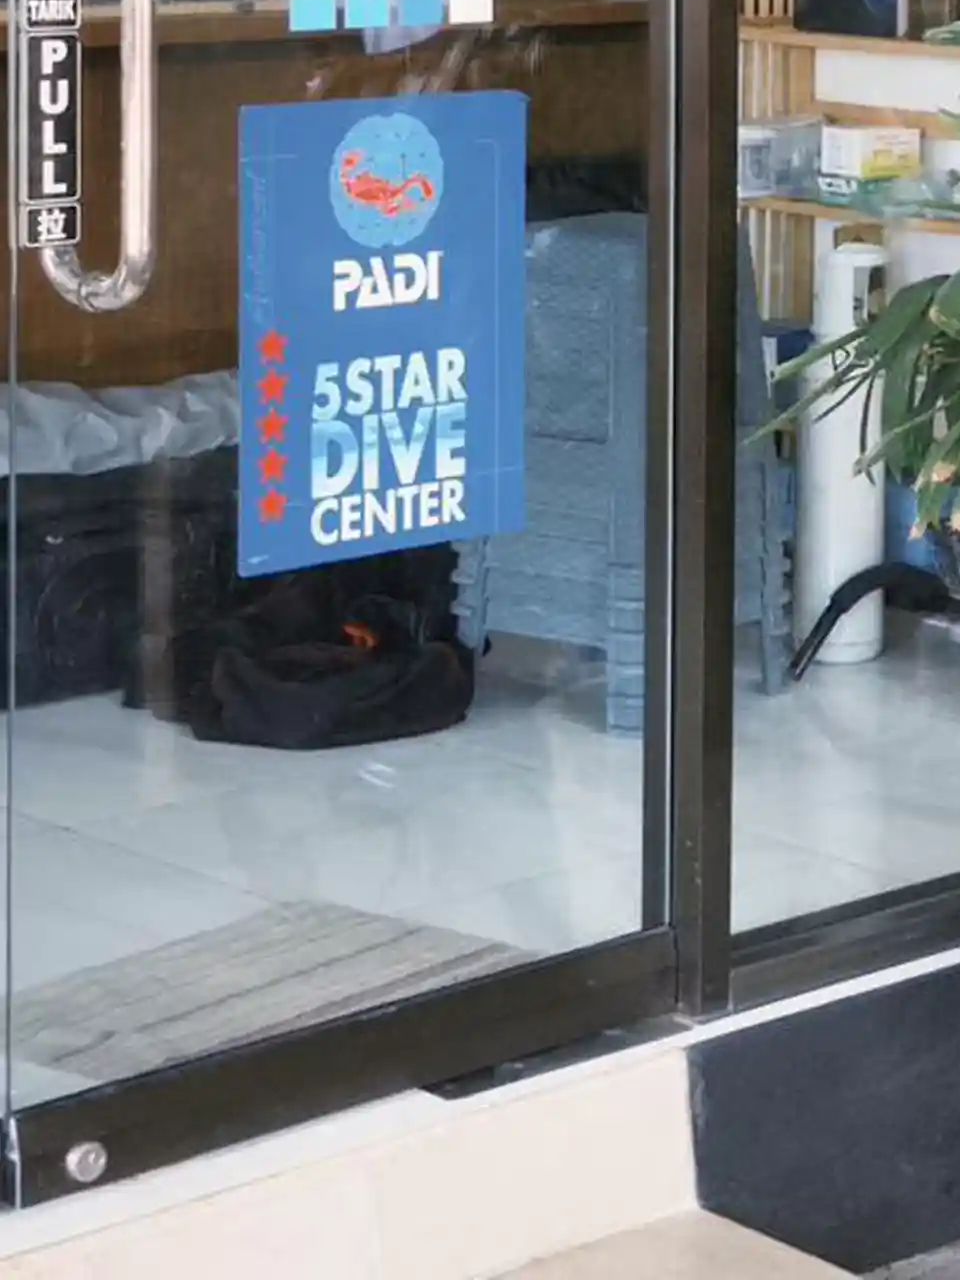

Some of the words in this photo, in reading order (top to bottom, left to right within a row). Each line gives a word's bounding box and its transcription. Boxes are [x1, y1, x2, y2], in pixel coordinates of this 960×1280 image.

[38, 39, 69, 195] PULL
[37, 208, 67, 242] 拉
[332, 251, 442, 312] PADI
[311, 362, 340, 422] 5
[345, 347, 467, 418] STAR
[310, 402, 467, 501] DIVE
[310, 480, 466, 547] CENTER
